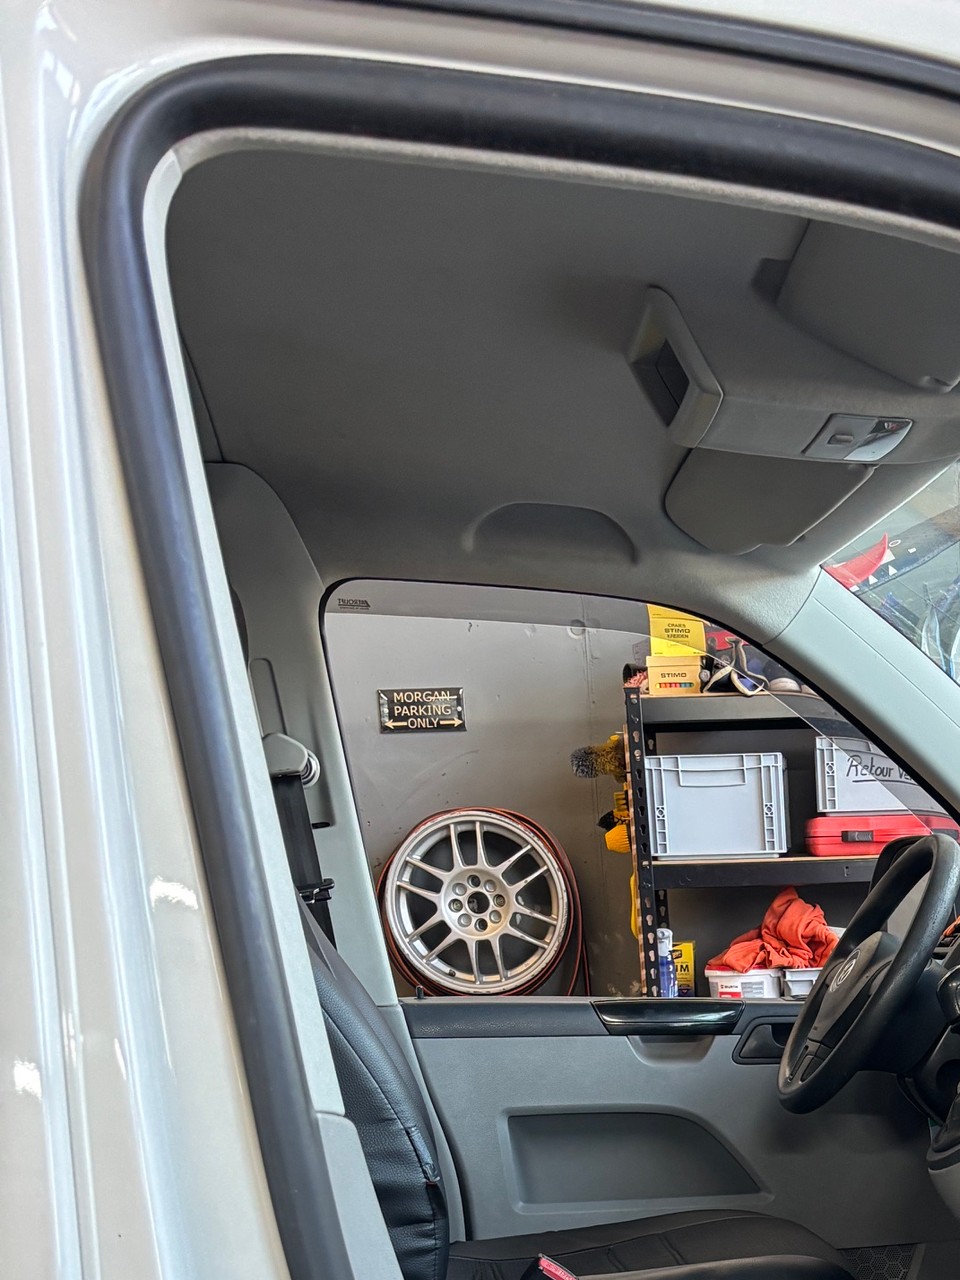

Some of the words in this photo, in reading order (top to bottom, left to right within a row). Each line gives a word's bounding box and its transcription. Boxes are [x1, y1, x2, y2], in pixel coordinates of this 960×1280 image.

[393, 690, 450, 703] MORGAN
[394, 705, 451, 717] PARKING
[408, 717, 440, 729] ONLY
[846, 754, 894, 778] Retour
